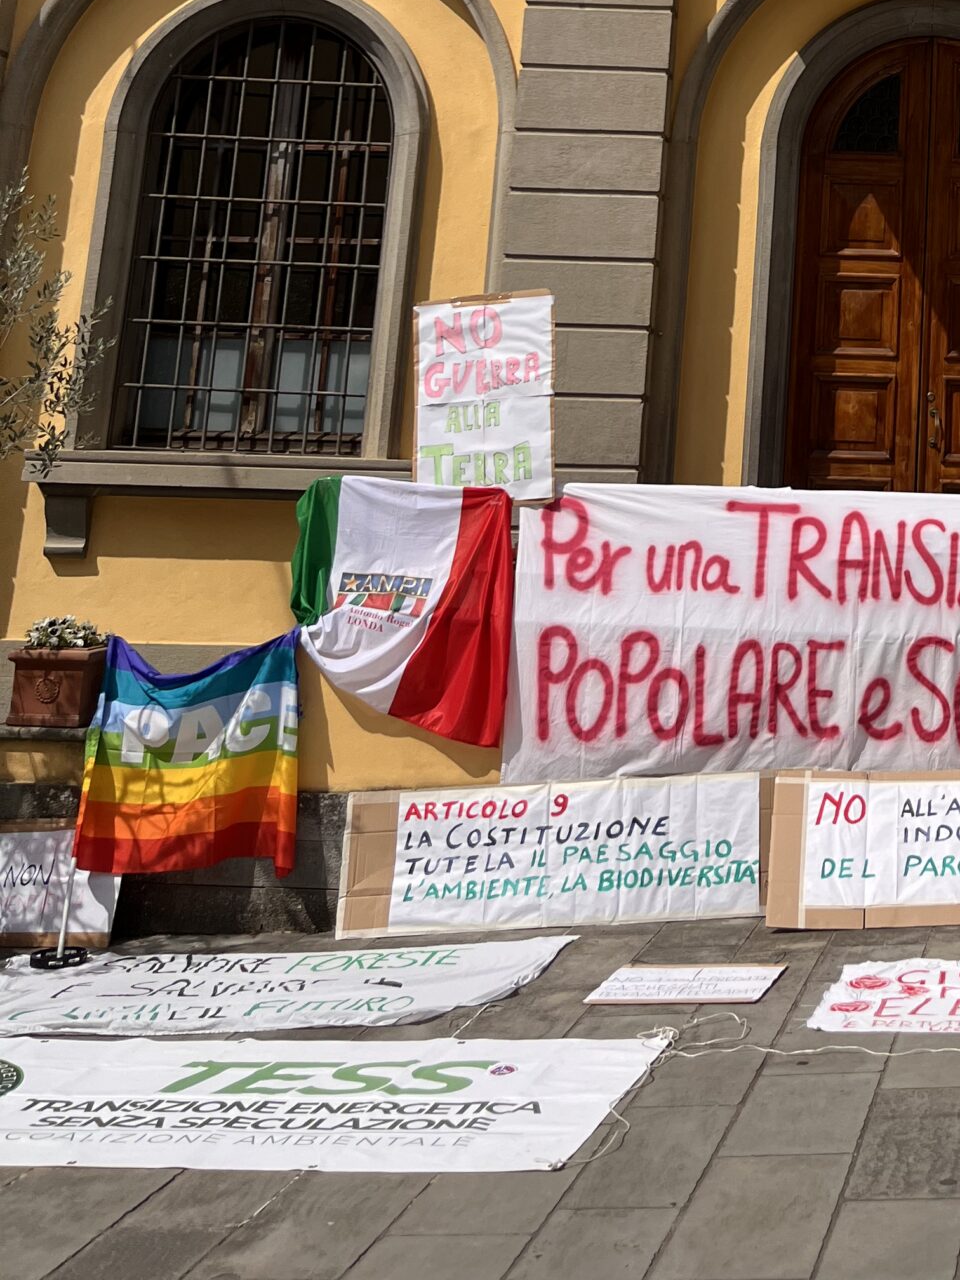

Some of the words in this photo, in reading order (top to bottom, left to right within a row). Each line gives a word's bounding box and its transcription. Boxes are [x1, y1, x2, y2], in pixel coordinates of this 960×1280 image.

[432, 306, 504, 357] NO
[423, 351, 542, 399] GUERRA
[444, 401, 501, 434] ALLA
[419, 440, 534, 488] TERRA
[540, 497, 632, 596] Per
[646, 540, 740, 595] una
[360, 575, 427, 596] A.N.P.I.
[347, 616, 384, 632] LONDA
[536, 624, 846, 747] POPOLARE
[858, 678, 902, 741] e
[120, 683, 298, 764] PACE
[404, 799, 528, 821] ARTICOLO
[550, 794, 569, 817] 9
[815, 791, 867, 826] NO
[404, 830, 432, 851] LA
[446, 815, 670, 849] COSTITUZIONE
[3, 859, 56, 888] NON
[405, 851, 515, 876] TUTELA
[530, 848, 546, 868] IL
[563, 839, 732, 866] PAESAGGIO
[820, 857, 876, 880] DEL
[402, 874, 554, 904] L'AMBIENTE,
[560, 875, 588, 893] LA
[284, 948, 474, 974] FORESTE
[156, 1059, 501, 1096] TESS
[20, 1098, 287, 1114] TRANSIZIONE
[285, 1100, 542, 1115] ENERGETICA
[29, 1114, 167, 1129] SENZA
[170, 1116, 497, 1131] SPECULAZIONE
[4, 1131, 228, 1145] COALIZIONE
[233, 1134, 475, 1148] AMBIENTALE
